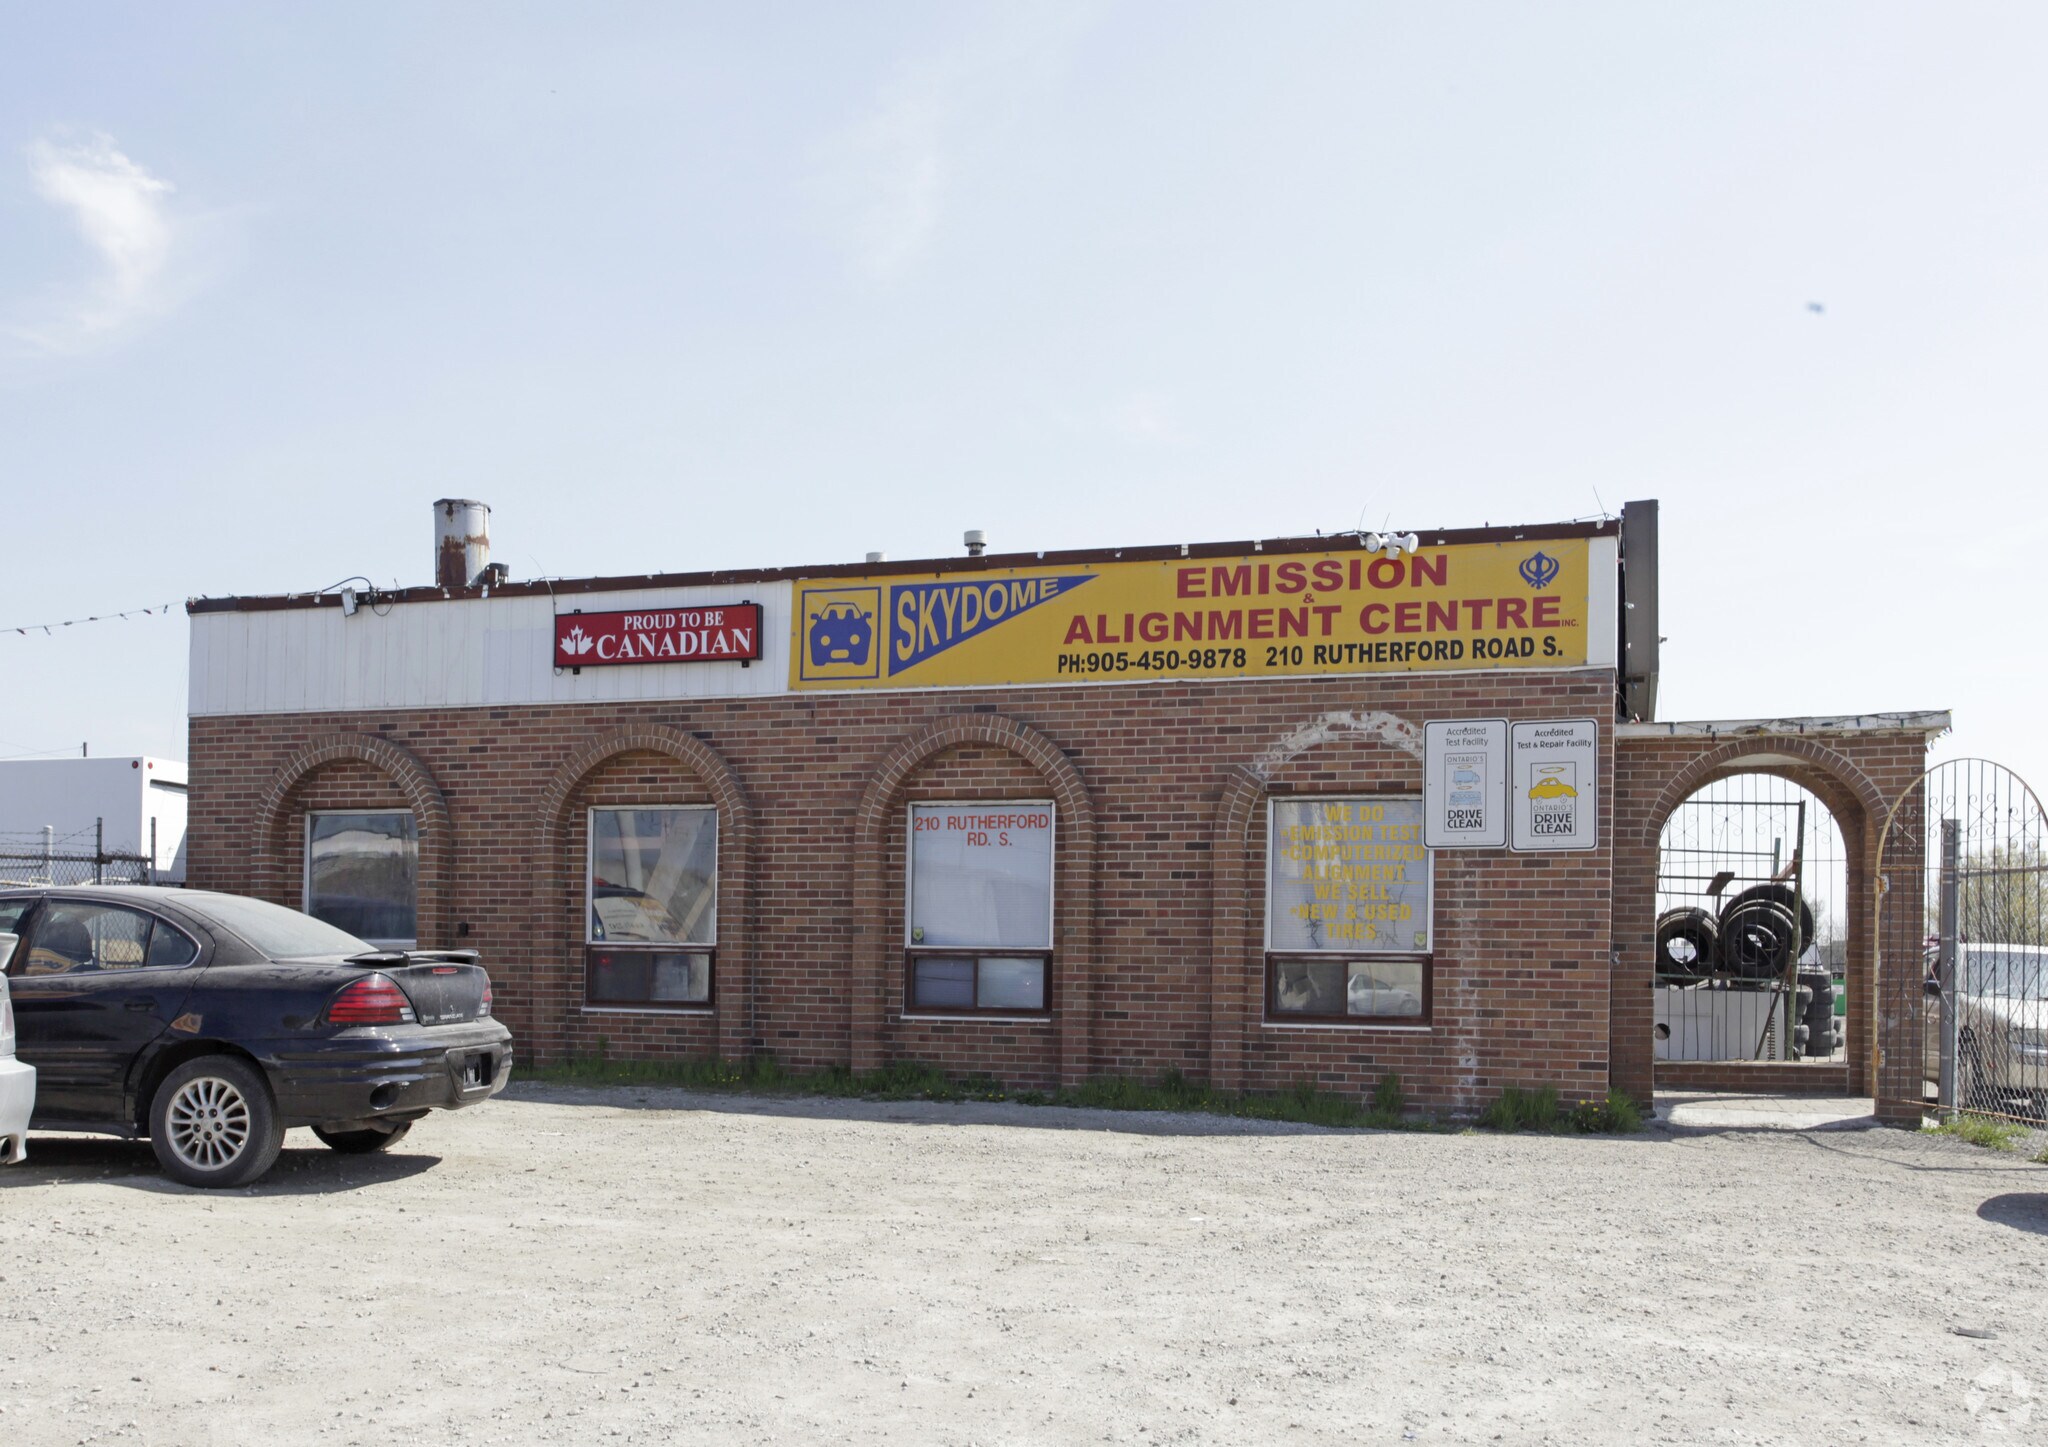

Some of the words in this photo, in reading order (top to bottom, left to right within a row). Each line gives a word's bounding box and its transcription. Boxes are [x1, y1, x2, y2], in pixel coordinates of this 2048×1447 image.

[1176, 554, 1448, 599] EMISSION
[1302, 593, 1315, 604] &
[624, 614, 676, 631] PROUD
[679, 613, 700, 628] TO
[705, 611, 724, 627] BE
[896, 577, 1060, 660] SKYDOME
[1063, 605, 1342, 645] ALIGNMENT
[1359, 596, 1561, 635] CENTRE
[1561, 618, 1579, 627] INC.
[596, 627, 752, 660] CANADIAN
[1057, 647, 1247, 674] PH:905-450-9878
[1265, 645, 1303, 667] 210
[1313, 639, 1464, 665] RUTHERFORD
[1471, 636, 1535, 660] ROAD
[1542, 635, 1563, 657] S.
[1446, 727, 1487, 736] Accredited
[1534, 728, 1574, 737] Accredited
[1445, 738, 1460, 747] Test
[1462, 737, 1489, 747] Facility
[1517, 741, 1532, 749] Test
[1539, 740, 1564, 750] Repair
[1566, 739, 1592, 749] Facility
[1446, 755, 1484, 763] ONTARIO'S
[1325, 805, 1354, 821] WE
[1359, 805, 1384, 821] DO
[1447, 809, 1483, 819] DRIVE
[1534, 813, 1573, 824] DRIVE
[914, 816, 940, 832] 210
[947, 814, 1049, 831] RUTHERFORD
[1447, 819, 1483, 829] CLEAN
[1533, 824, 1573, 834] CLEAN
[967, 832, 991, 847] RD.
[998, 832, 1013, 847] S.
[1381, 824, 1421, 841] TEST
[1302, 864, 1405, 881] ALIGNMENT
[1314, 884, 1344, 900] WE
[1349, 884, 1391, 900] SELL
[1345, 904, 1357, 920] &
[1364, 904, 1412, 920] USED
[1325, 923, 1377, 940] TIRES
